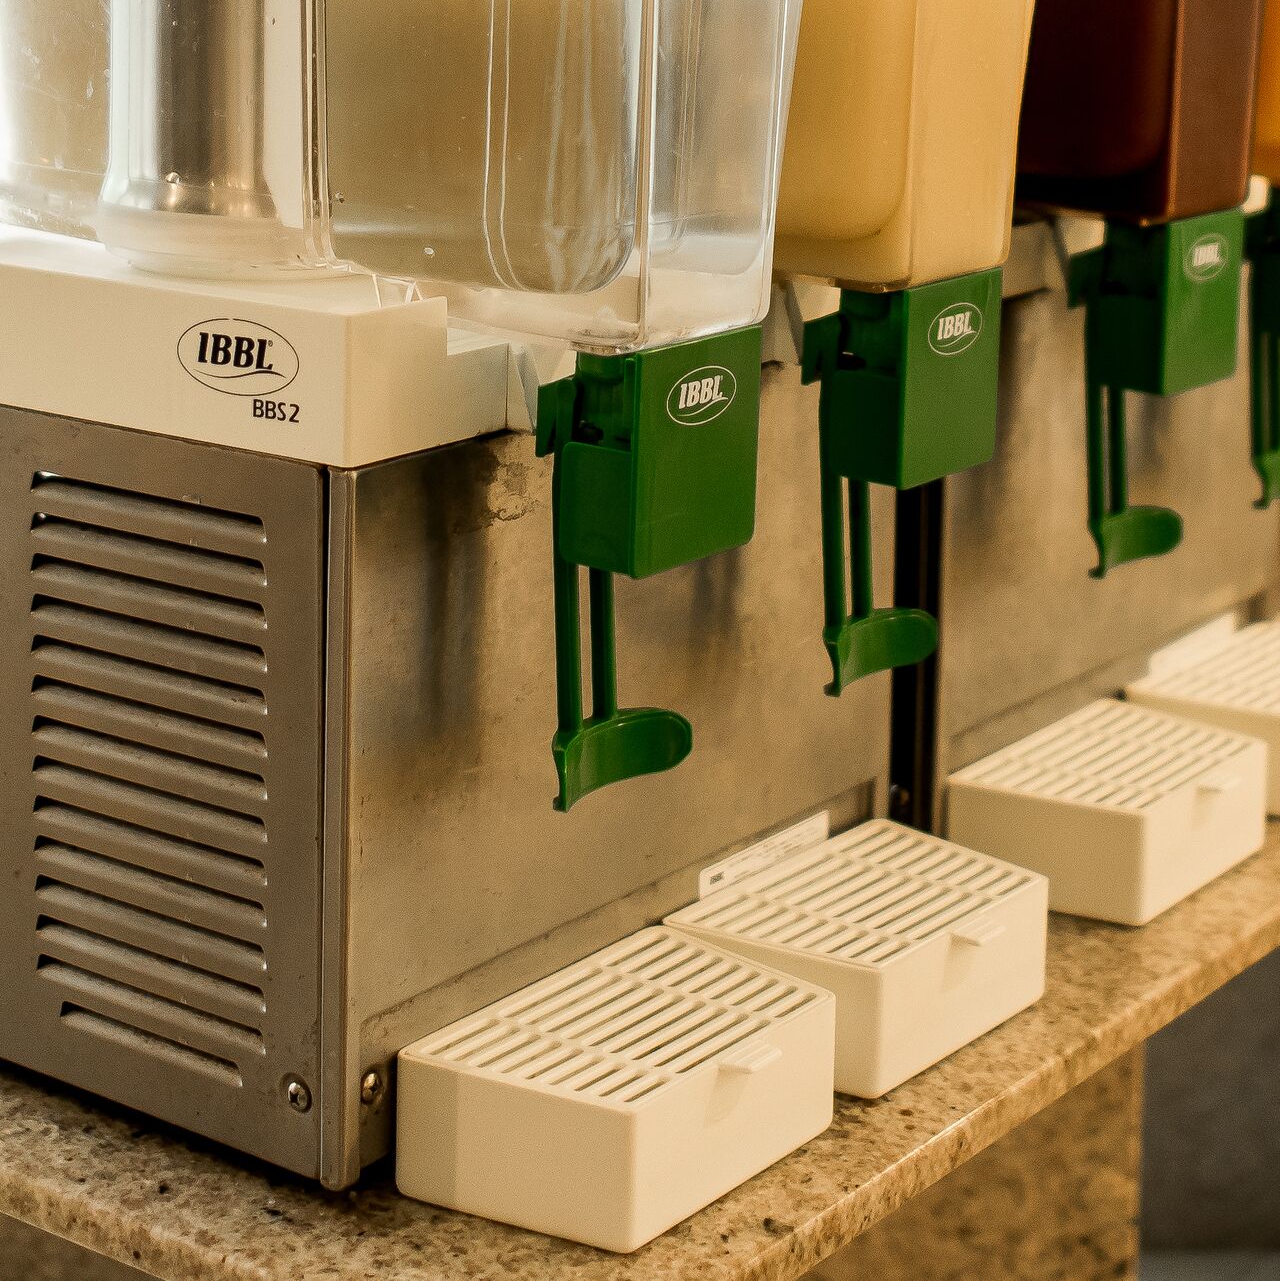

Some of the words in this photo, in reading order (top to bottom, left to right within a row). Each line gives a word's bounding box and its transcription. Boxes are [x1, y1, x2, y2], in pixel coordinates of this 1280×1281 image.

[937, 311, 972, 340] IBBL
[197, 331, 274, 370] IBBL
[679, 375, 723, 409] IBBL
